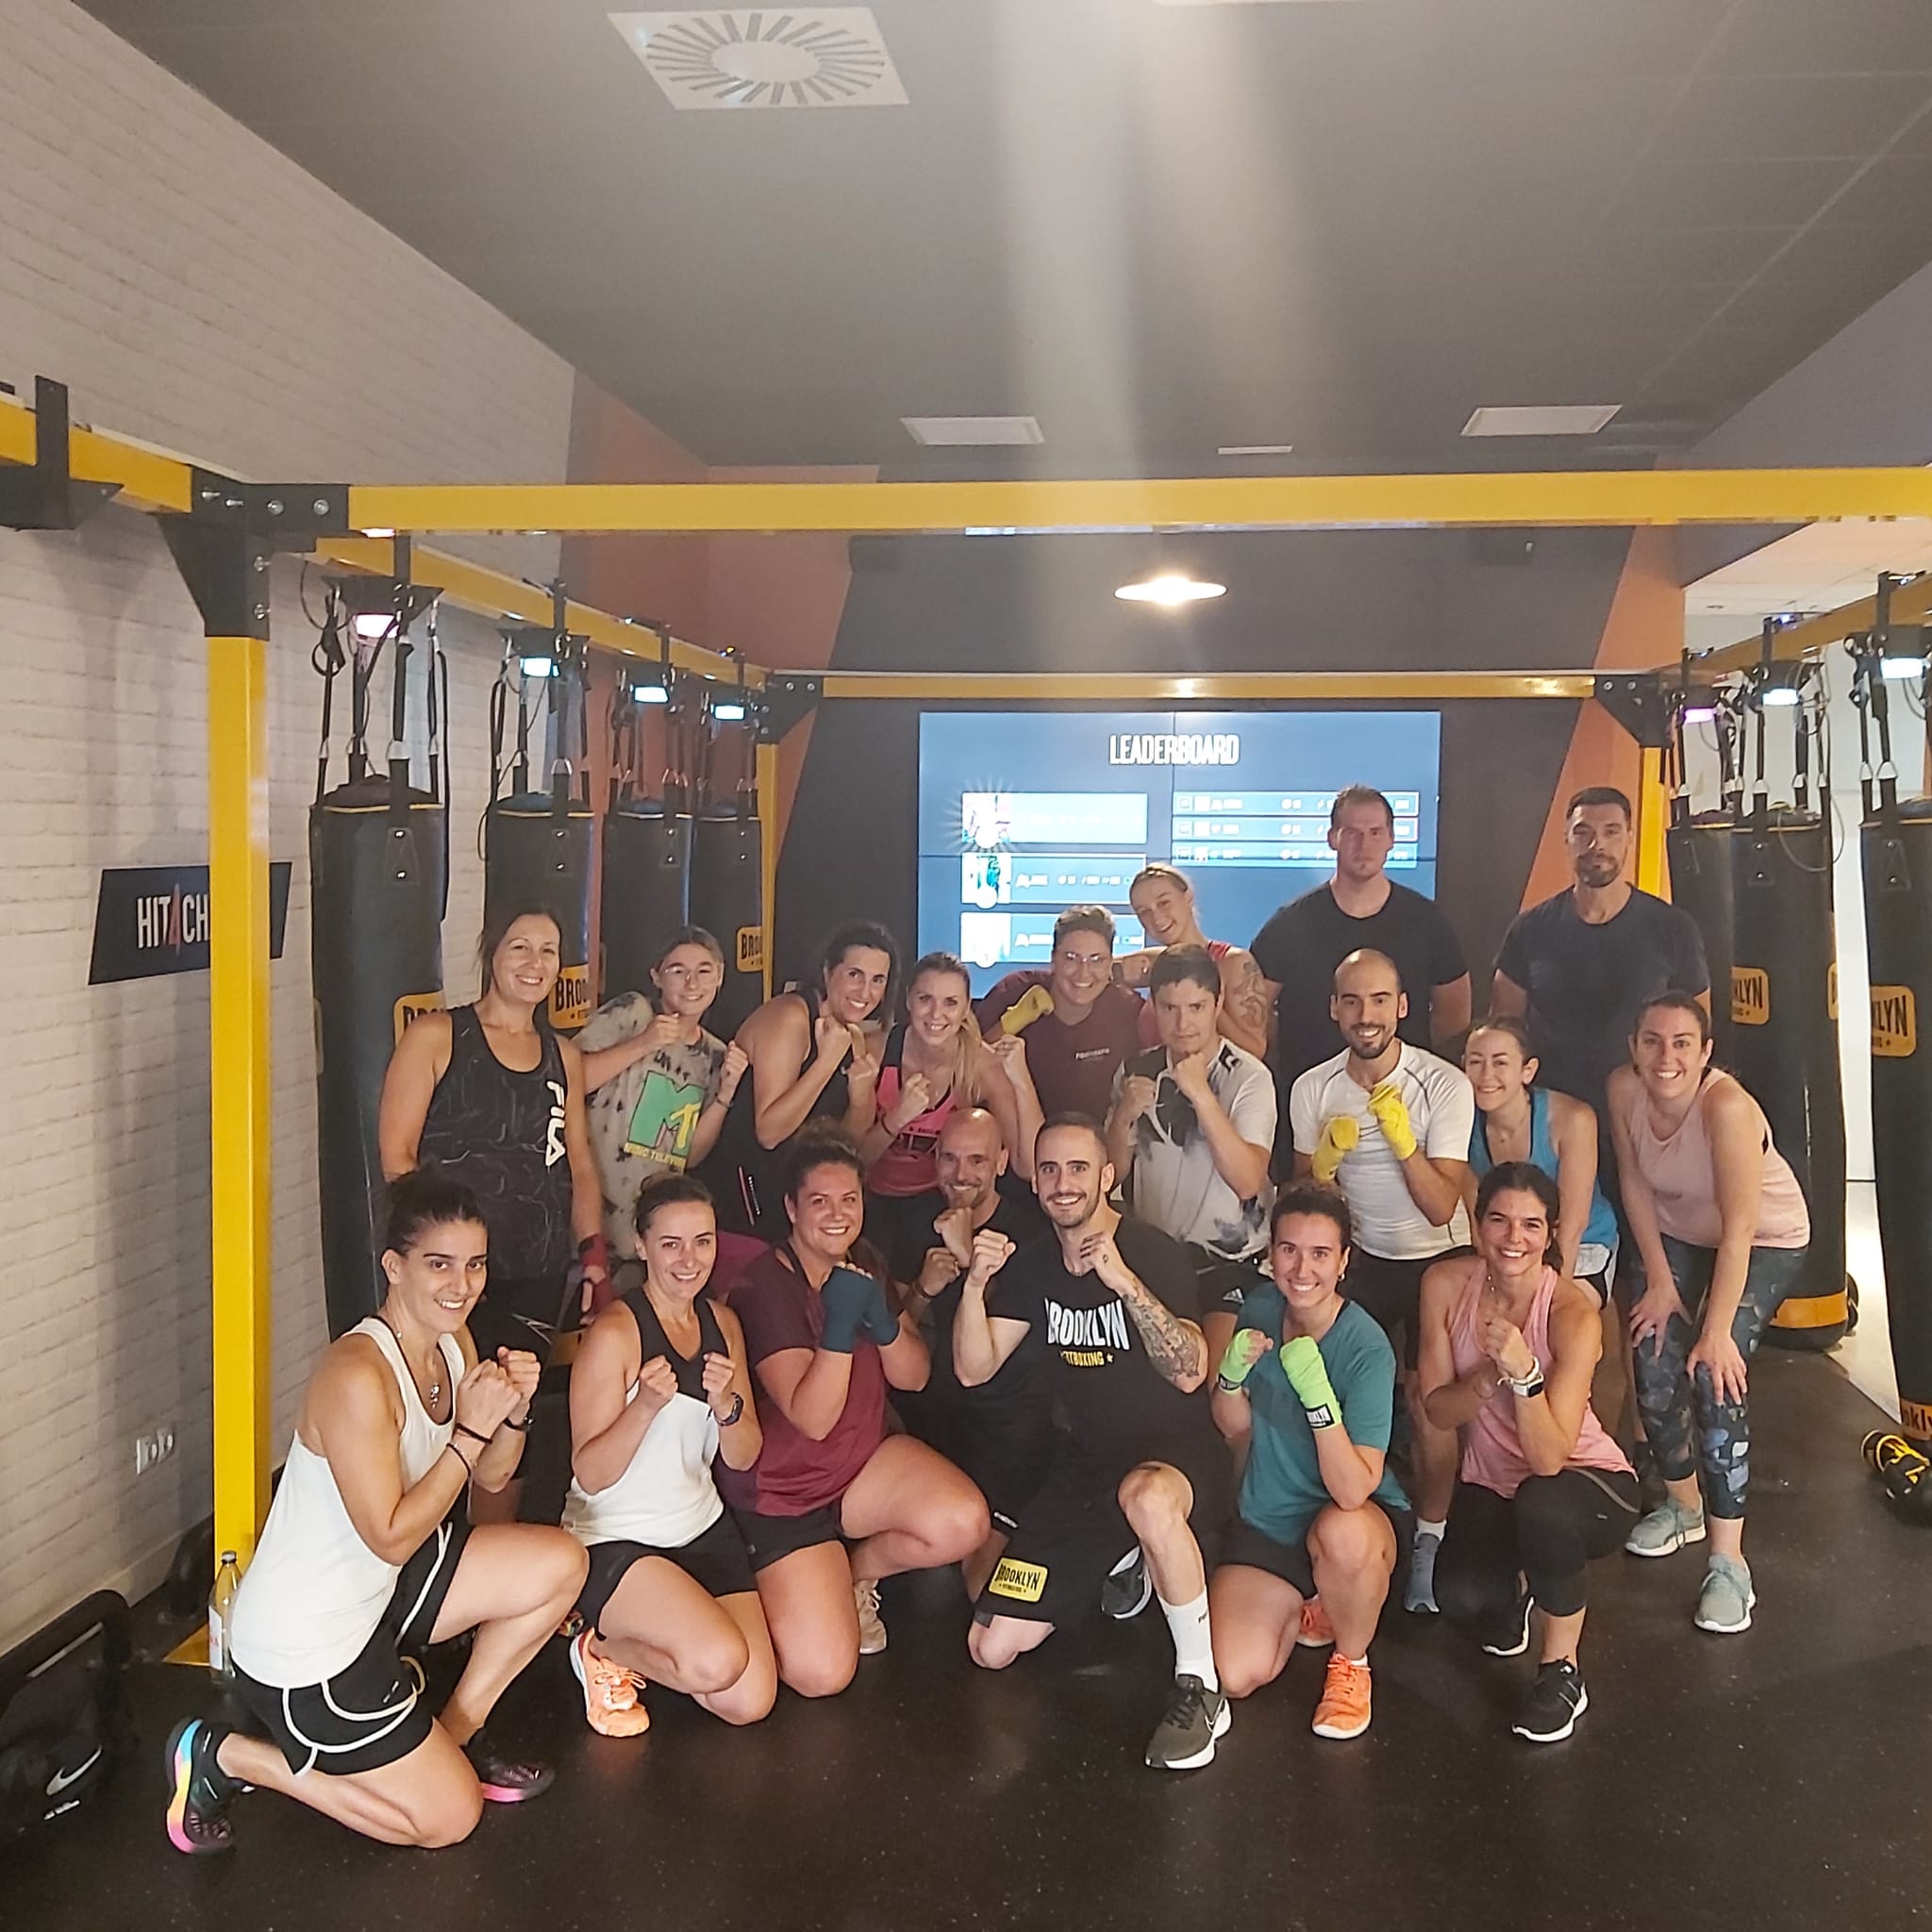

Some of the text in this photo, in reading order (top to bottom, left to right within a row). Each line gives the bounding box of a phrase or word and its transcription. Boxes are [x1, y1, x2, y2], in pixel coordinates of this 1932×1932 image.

[1109, 734, 1241, 766] LEADERBOARD
[137, 884, 209, 953] HITACH
[555, 976, 587, 1012] BRO
[1872, 993, 1907, 1038] LYN
[545, 1080, 566, 1167] FILA
